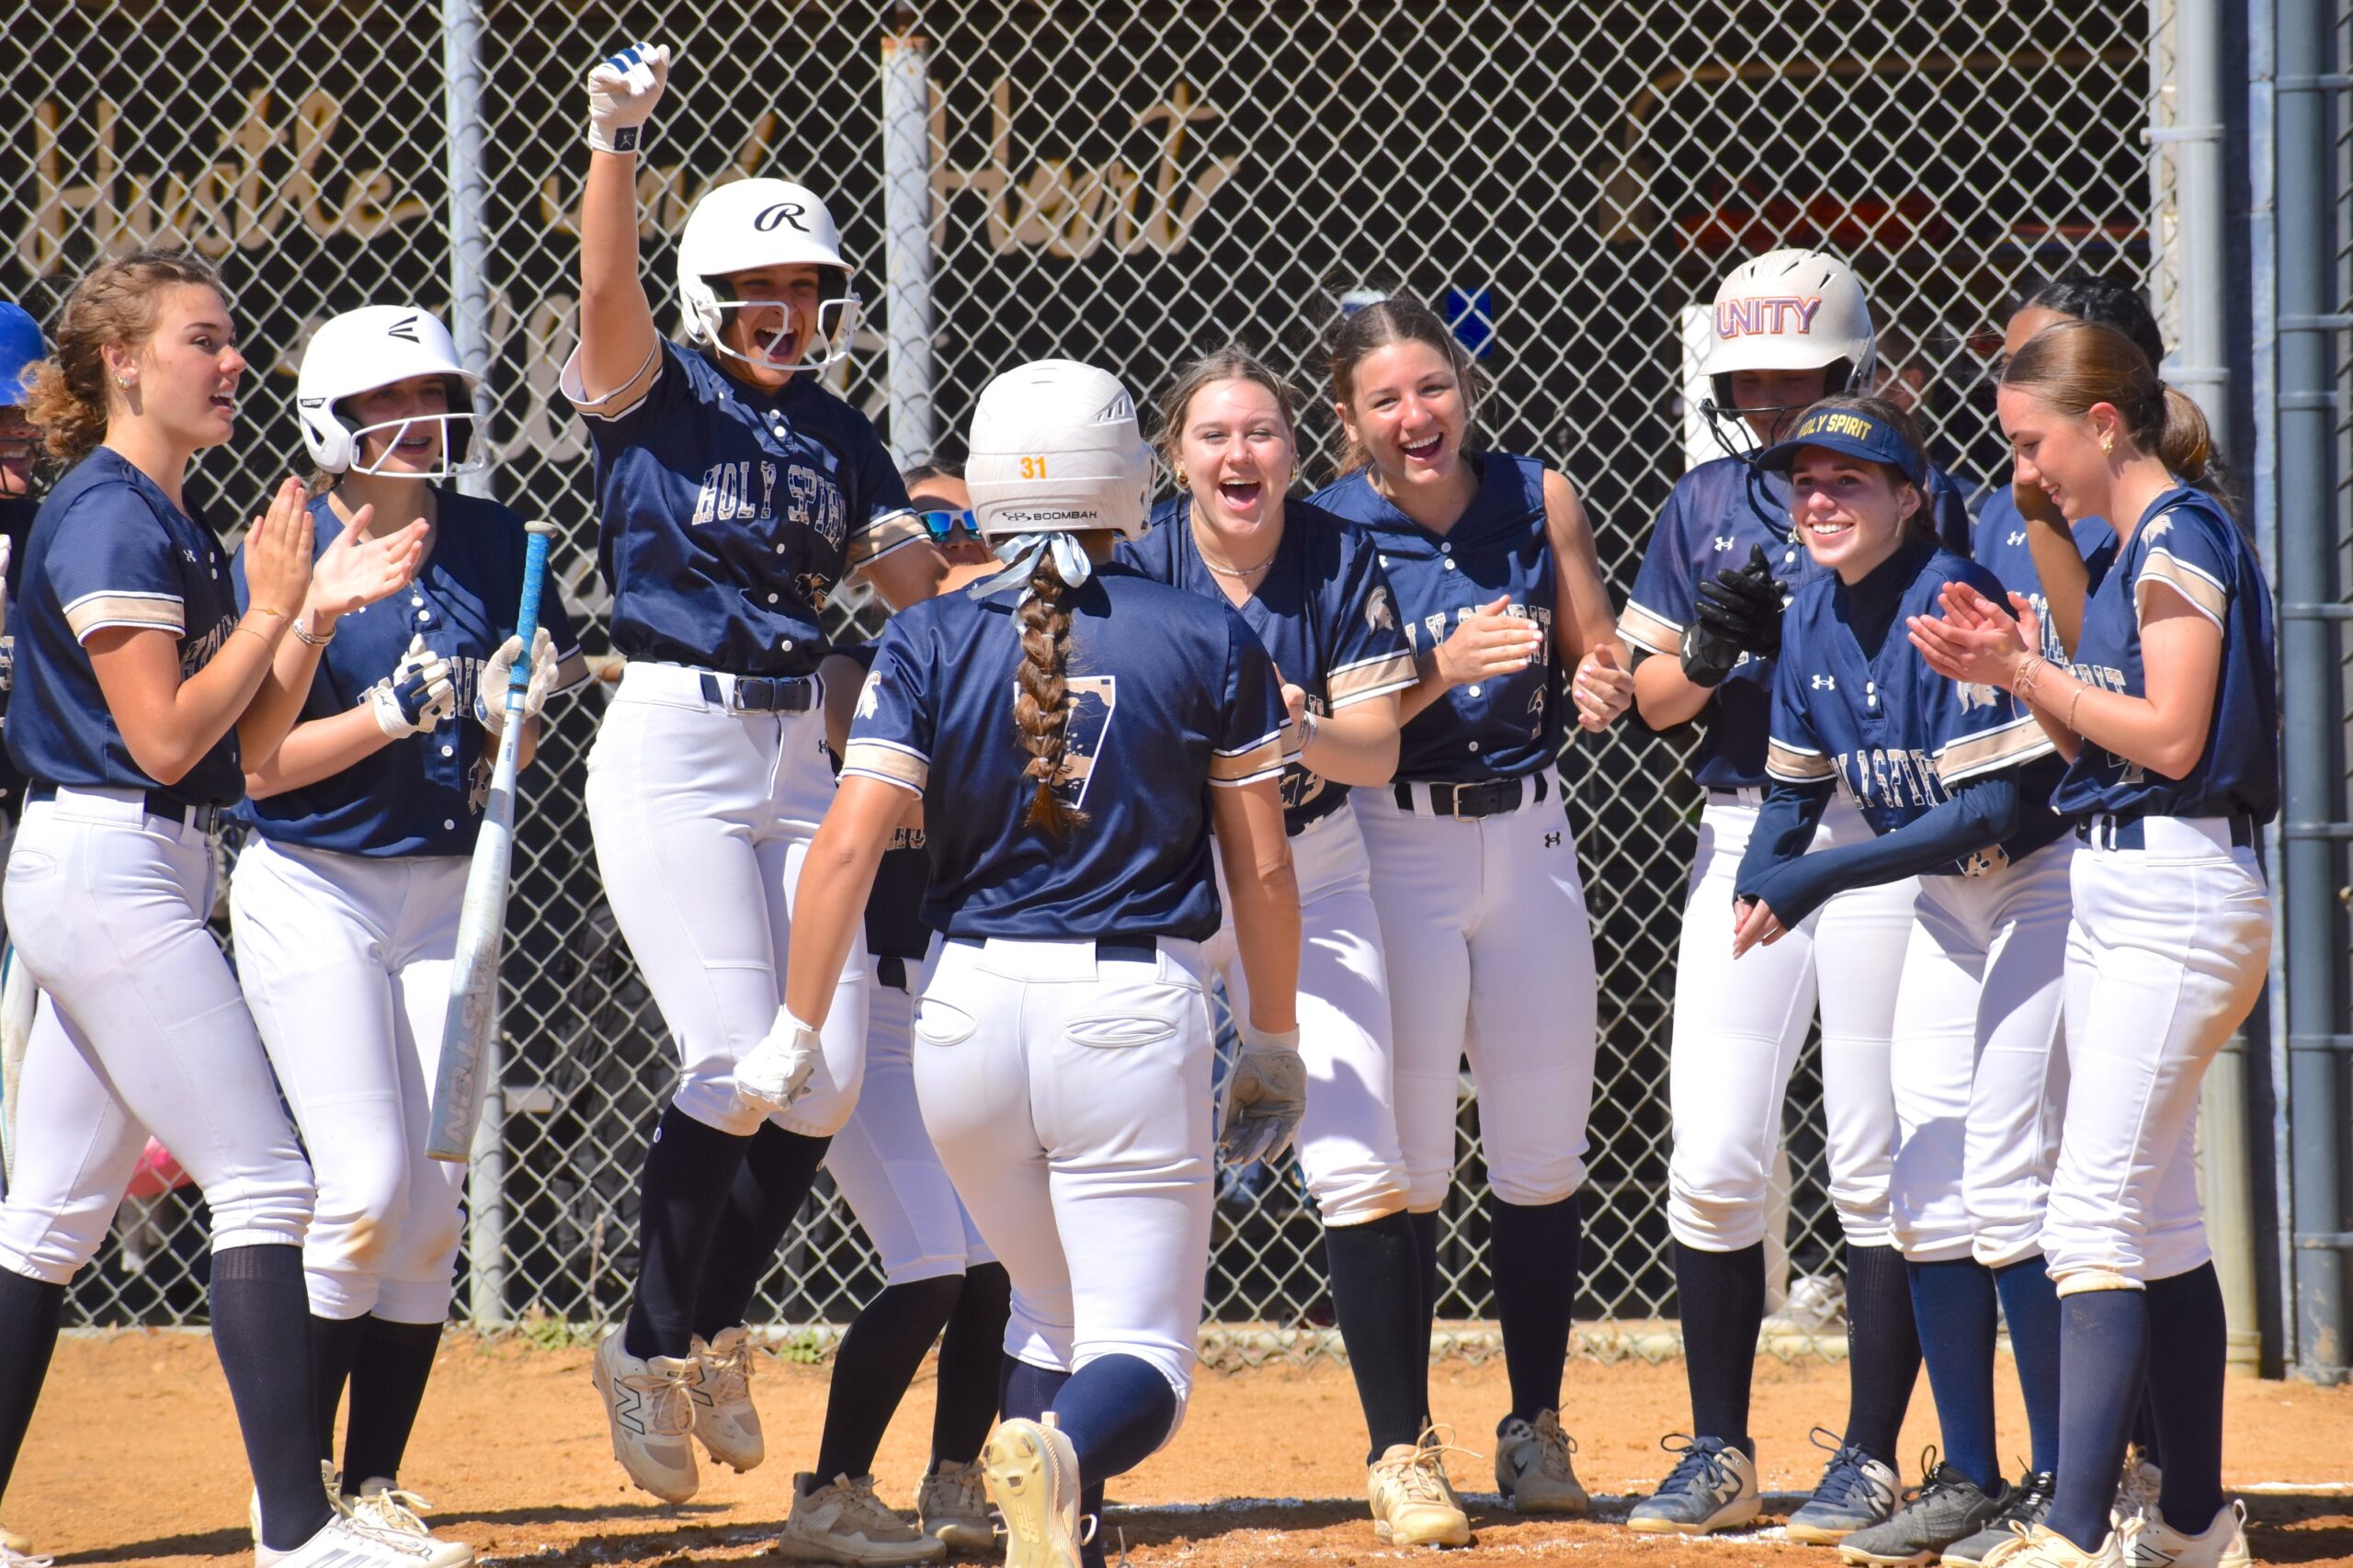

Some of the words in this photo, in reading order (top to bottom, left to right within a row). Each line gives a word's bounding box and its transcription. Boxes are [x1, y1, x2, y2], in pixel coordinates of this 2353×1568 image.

[17, 87, 429, 278] Hustle
[1716, 296, 1822, 341] UNITY
[1825, 414, 1872, 441] SPIRIT
[1019, 456, 1046, 479] 31
[691, 460, 777, 527] HOLY
[1033, 510, 1098, 521] BOOMBAH
[1014, 676, 1116, 810] 7
